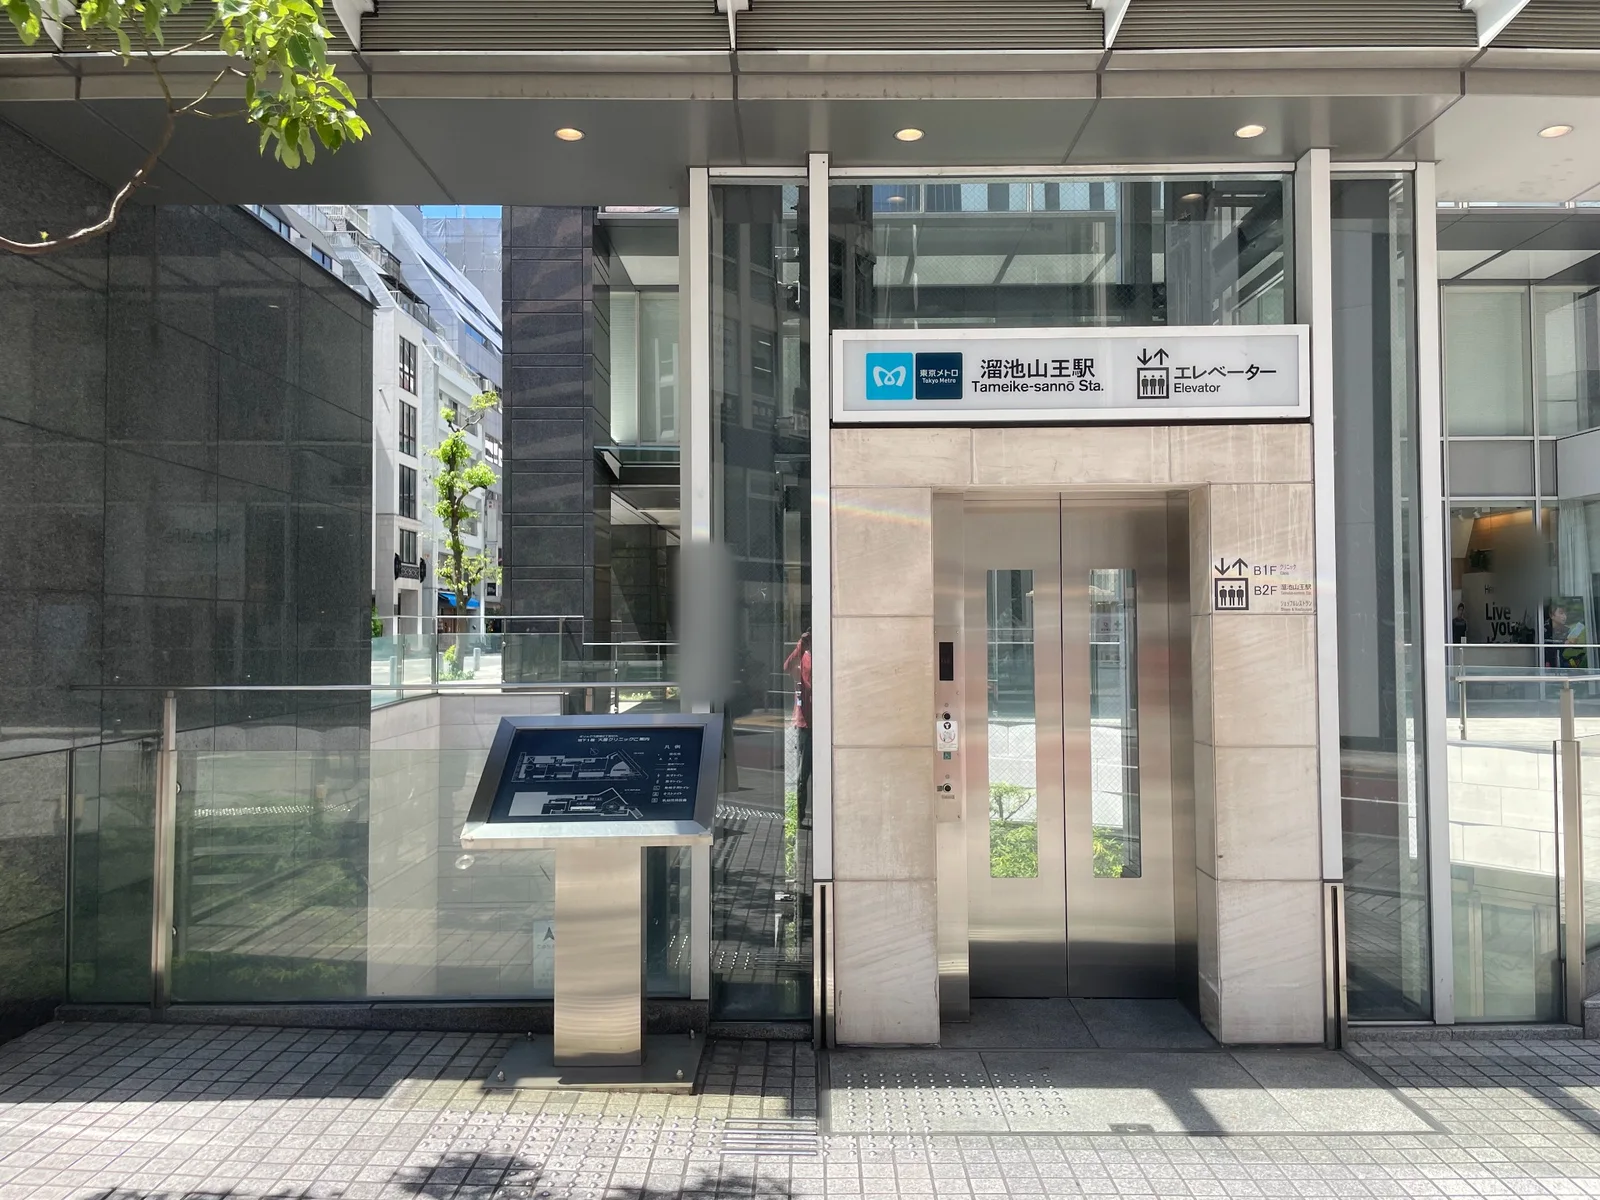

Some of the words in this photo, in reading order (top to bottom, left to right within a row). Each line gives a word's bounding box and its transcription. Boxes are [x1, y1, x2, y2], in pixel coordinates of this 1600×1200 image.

[919, 369, 959, 378] 東京メトロ
[980, 358, 1096, 379] 溜池山王駅
[1174, 364, 1277, 380] エレベーター
[971, 380, 1075, 393] Tameike-sannō
[1079, 380, 1104, 392] Sta.
[1174, 382, 1221, 393] Elevator
[1253, 565, 1277, 576] B1F
[1254, 584, 1278, 596] B2F
[1485, 602, 1511, 620] Live
